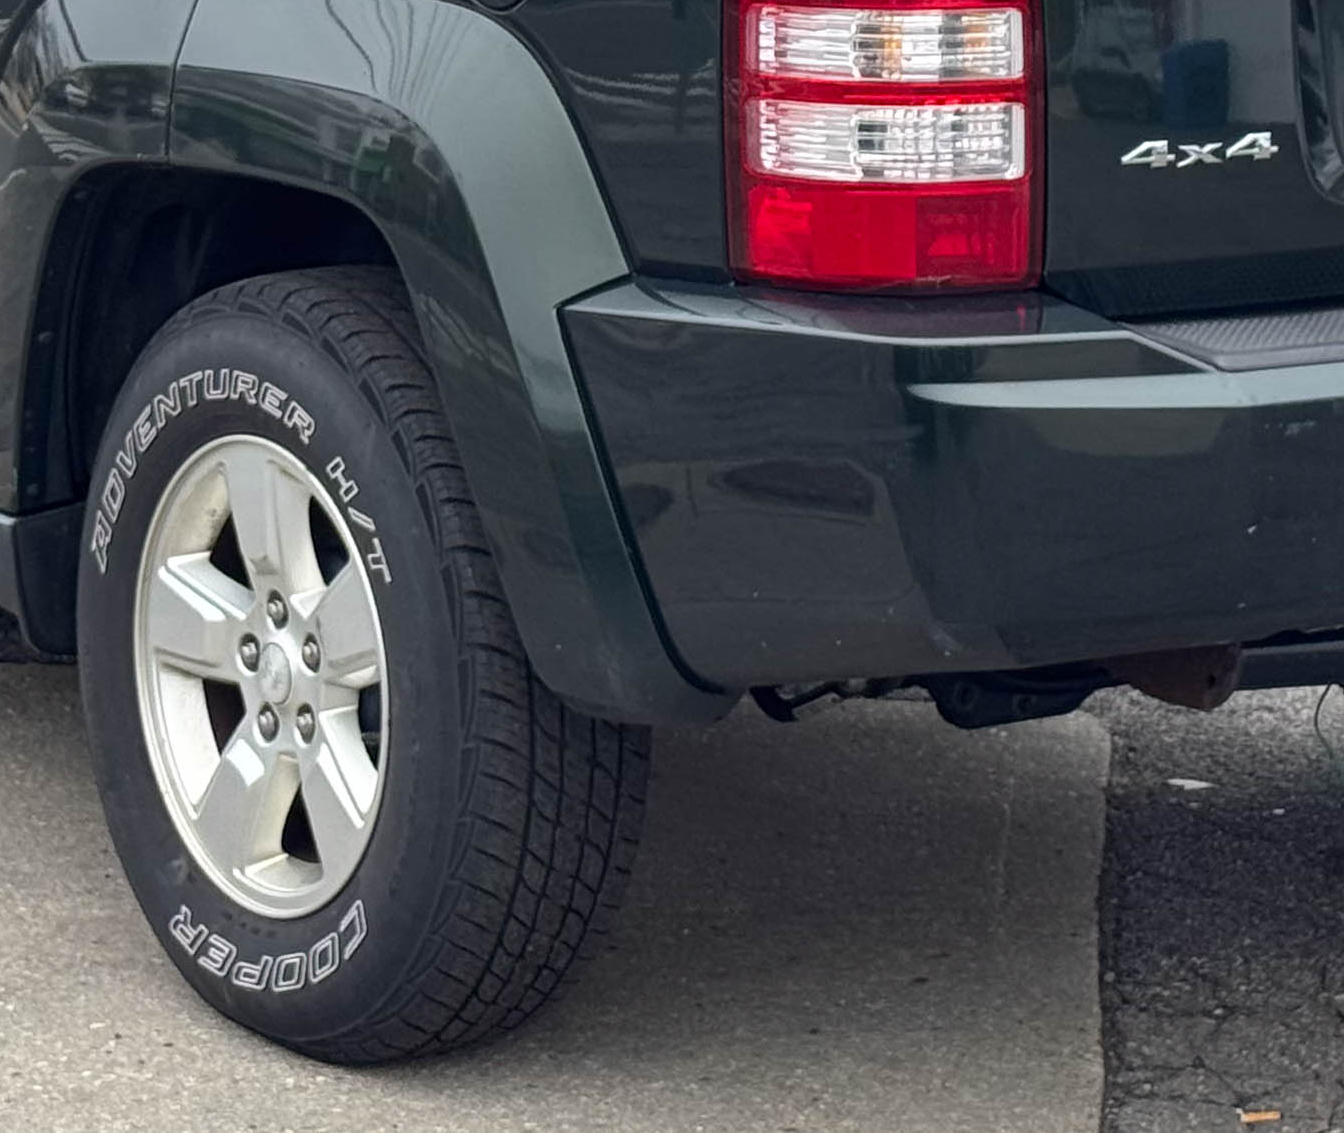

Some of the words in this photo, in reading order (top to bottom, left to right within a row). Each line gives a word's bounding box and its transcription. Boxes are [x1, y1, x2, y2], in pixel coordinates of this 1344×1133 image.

[1120, 131, 1279, 168] 4x4
[91, 368, 317, 575] ADVENTURER
[325, 455, 393, 585] H/T
[168, 899, 368, 993] COOPER
